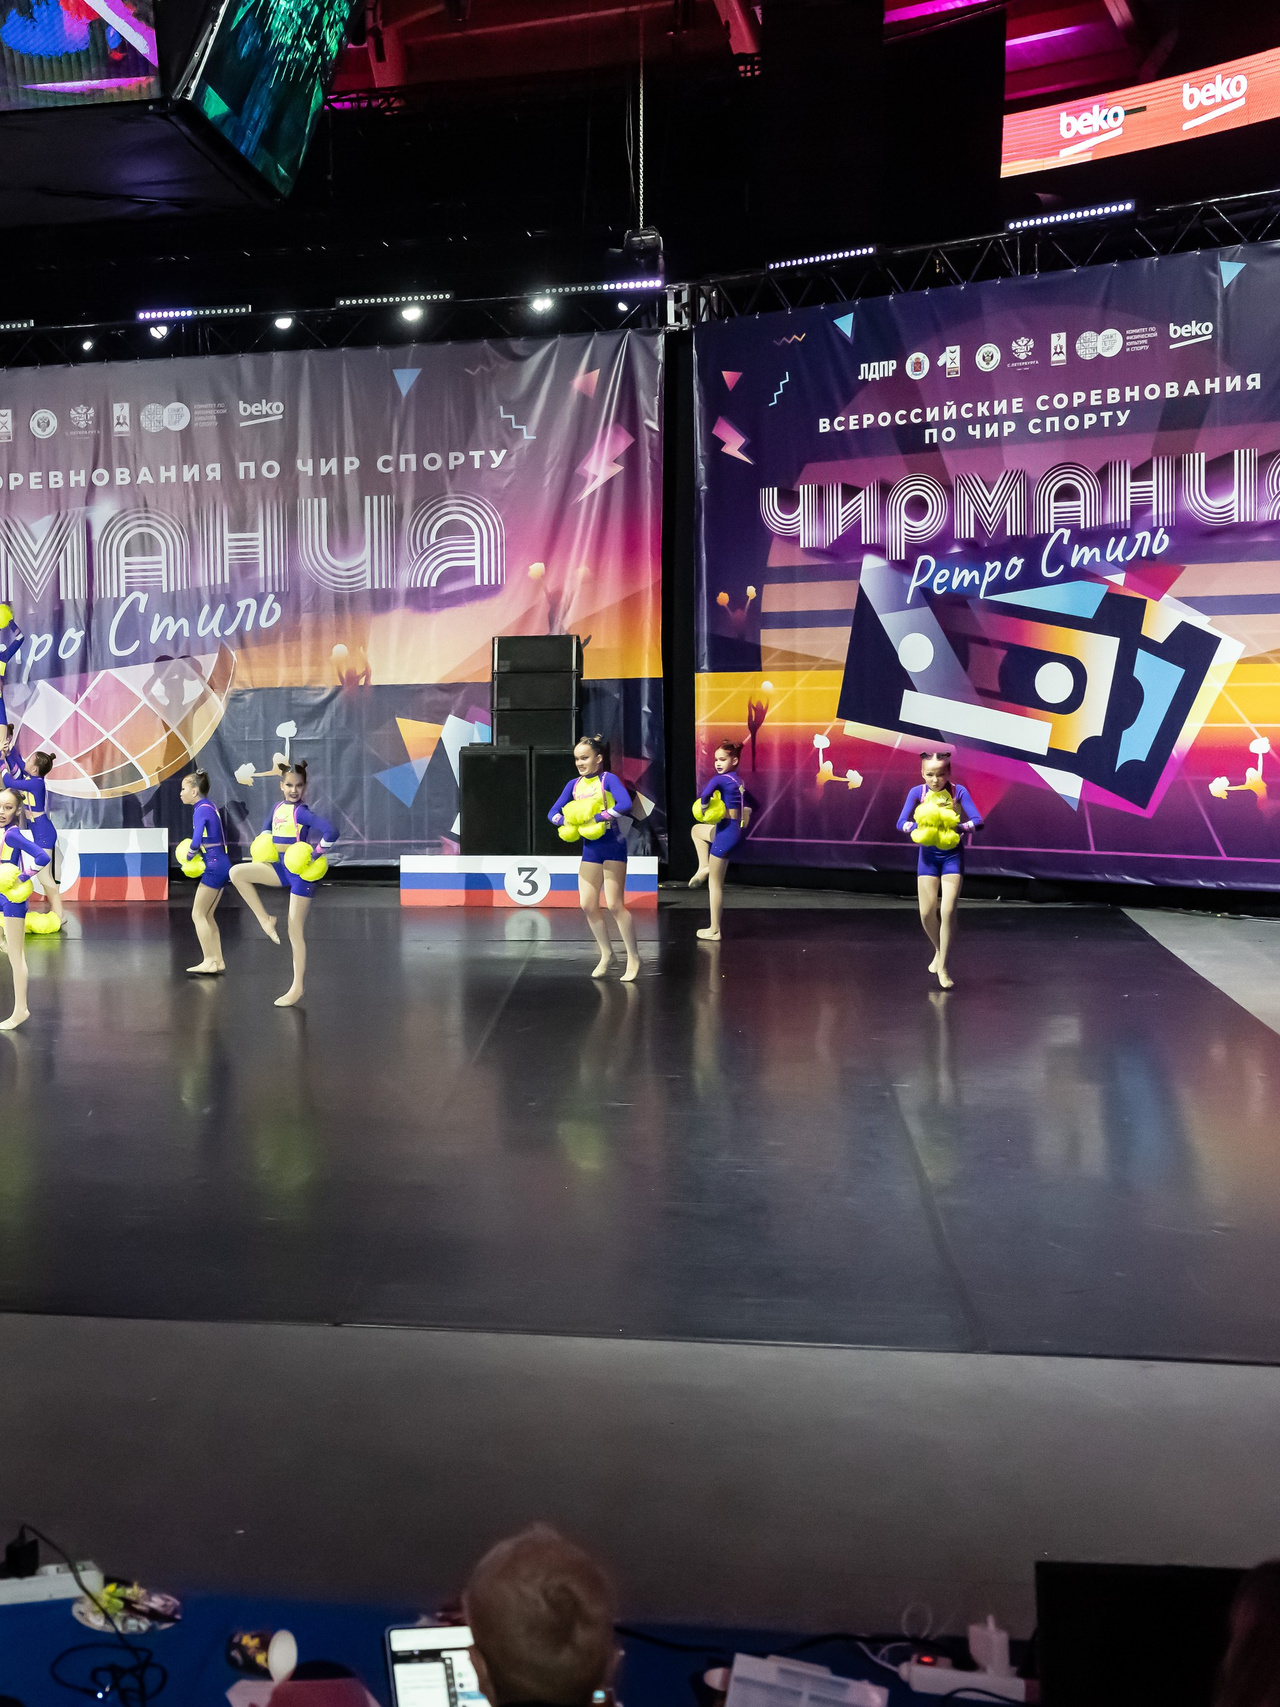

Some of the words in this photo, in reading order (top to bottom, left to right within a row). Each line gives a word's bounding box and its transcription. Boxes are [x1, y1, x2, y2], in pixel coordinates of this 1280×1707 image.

[1182, 73, 1248, 110] beko
[1059, 105, 1125, 139] beko
[1169, 320, 1213, 339] beko
[858, 360, 897, 381] ЛДПР
[239, 399, 285, 416] beko
[819, 397, 1023, 433] ВСЕРОССИЙСКИЕ
[1036, 373, 1261, 411] СОРЕВНОВАНИЯ
[924, 426, 956, 444] ПО
[967, 421, 1016, 440] ЧИР
[1028, 409, 1131, 434] СПОРТУ
[239, 460, 281, 479] ПО
[297, 456, 360, 476] ЧИР
[376, 449, 508, 474] СПОРТУ
[907, 552, 1023, 604] Ретро
[1040, 527, 1170, 578] Стиль
[108, 590, 282, 657] Стиль
[517, 866, 539, 897] 3
